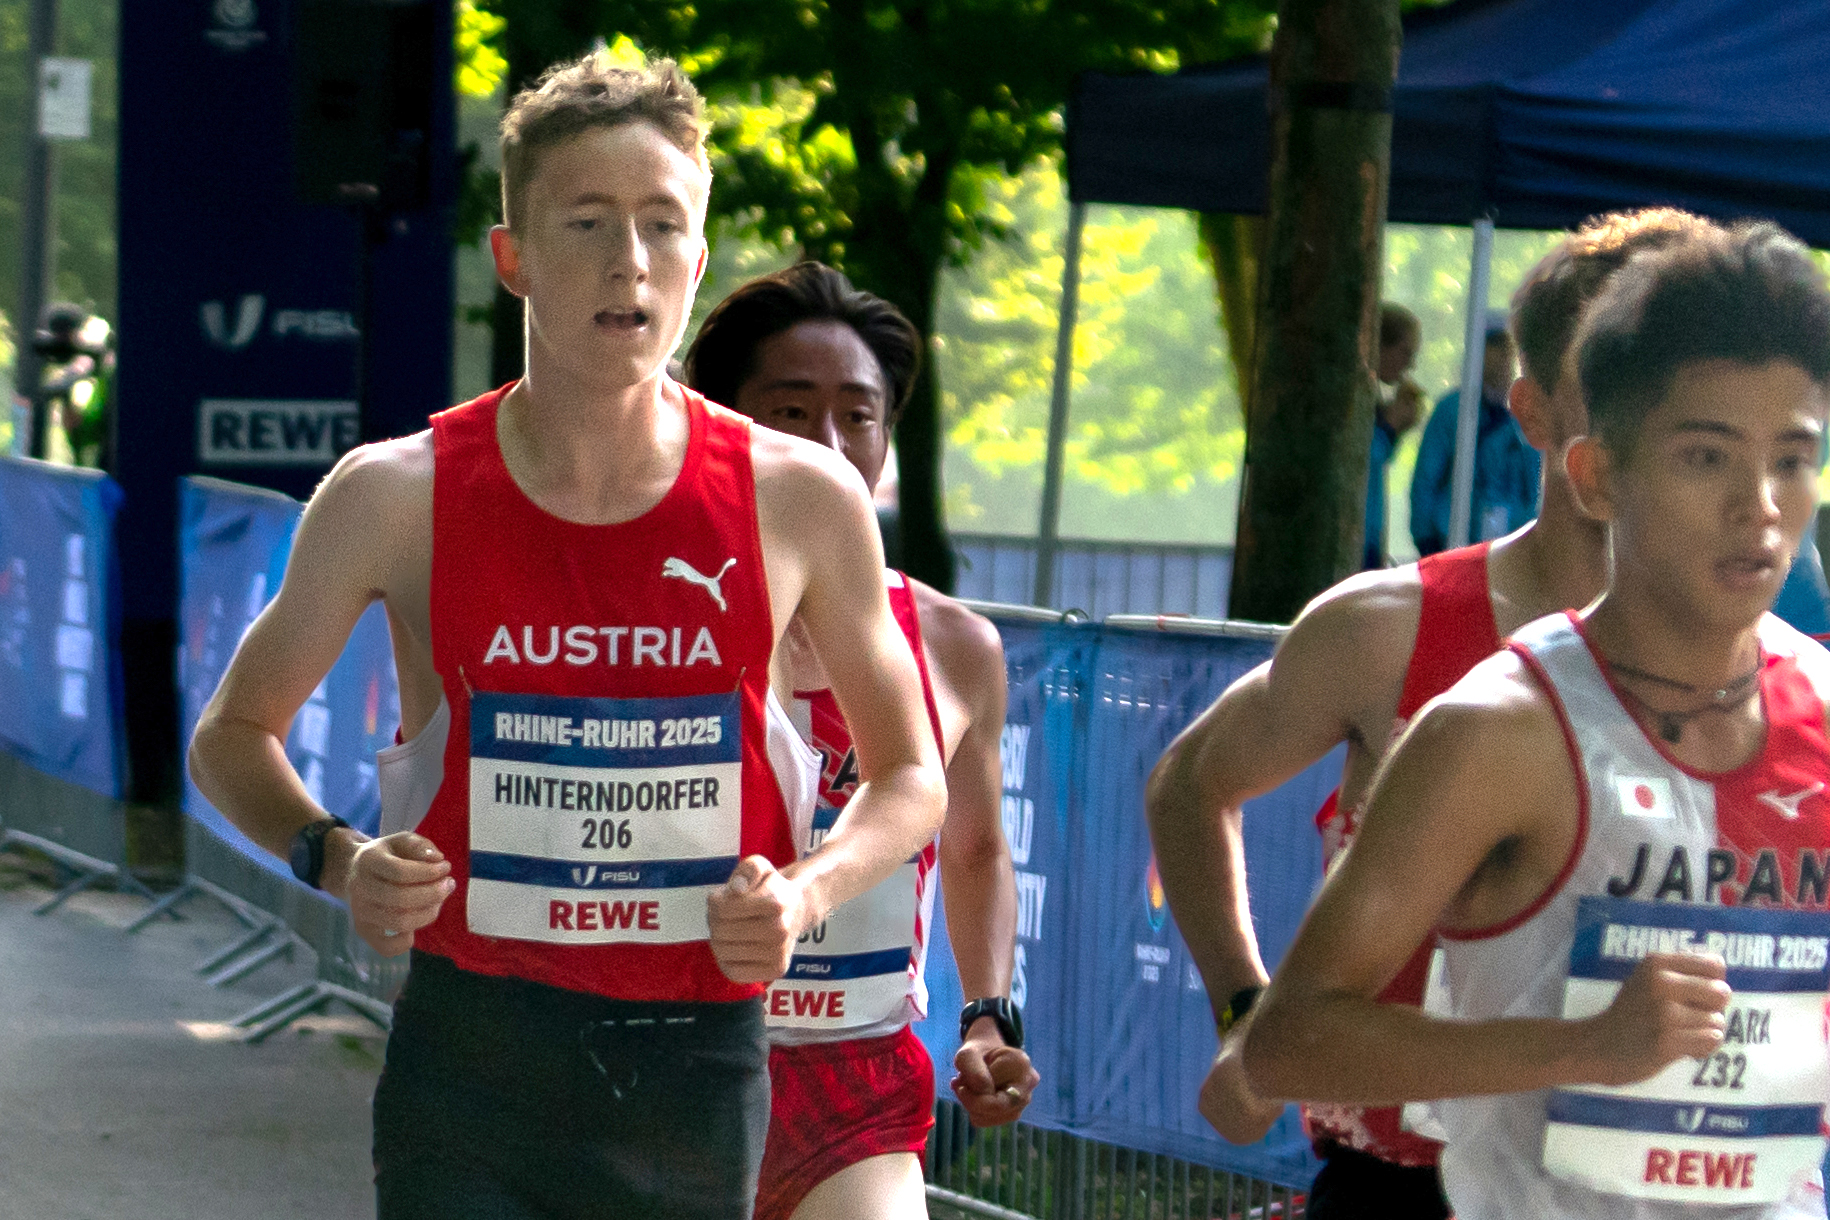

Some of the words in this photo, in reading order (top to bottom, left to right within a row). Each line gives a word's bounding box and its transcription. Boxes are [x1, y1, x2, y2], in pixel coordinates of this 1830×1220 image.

[211, 410, 358, 451] REWE
[483, 624, 723, 667] AUSTRIA
[495, 711, 657, 748] RHINE-RUHR
[660, 715, 723, 748] 2025
[495, 772, 720, 813] HINTERNDORFER
[581, 817, 633, 849] 206
[602, 870, 641, 882] FISU
[1607, 842, 1830, 904] JAPAN
[549, 899, 660, 931] REWE
[795, 963, 832, 974] FISU
[764, 988, 845, 1018] EWE
[1692, 1051, 1748, 1089] 232
[1643, 1147, 1757, 1190] REWE
